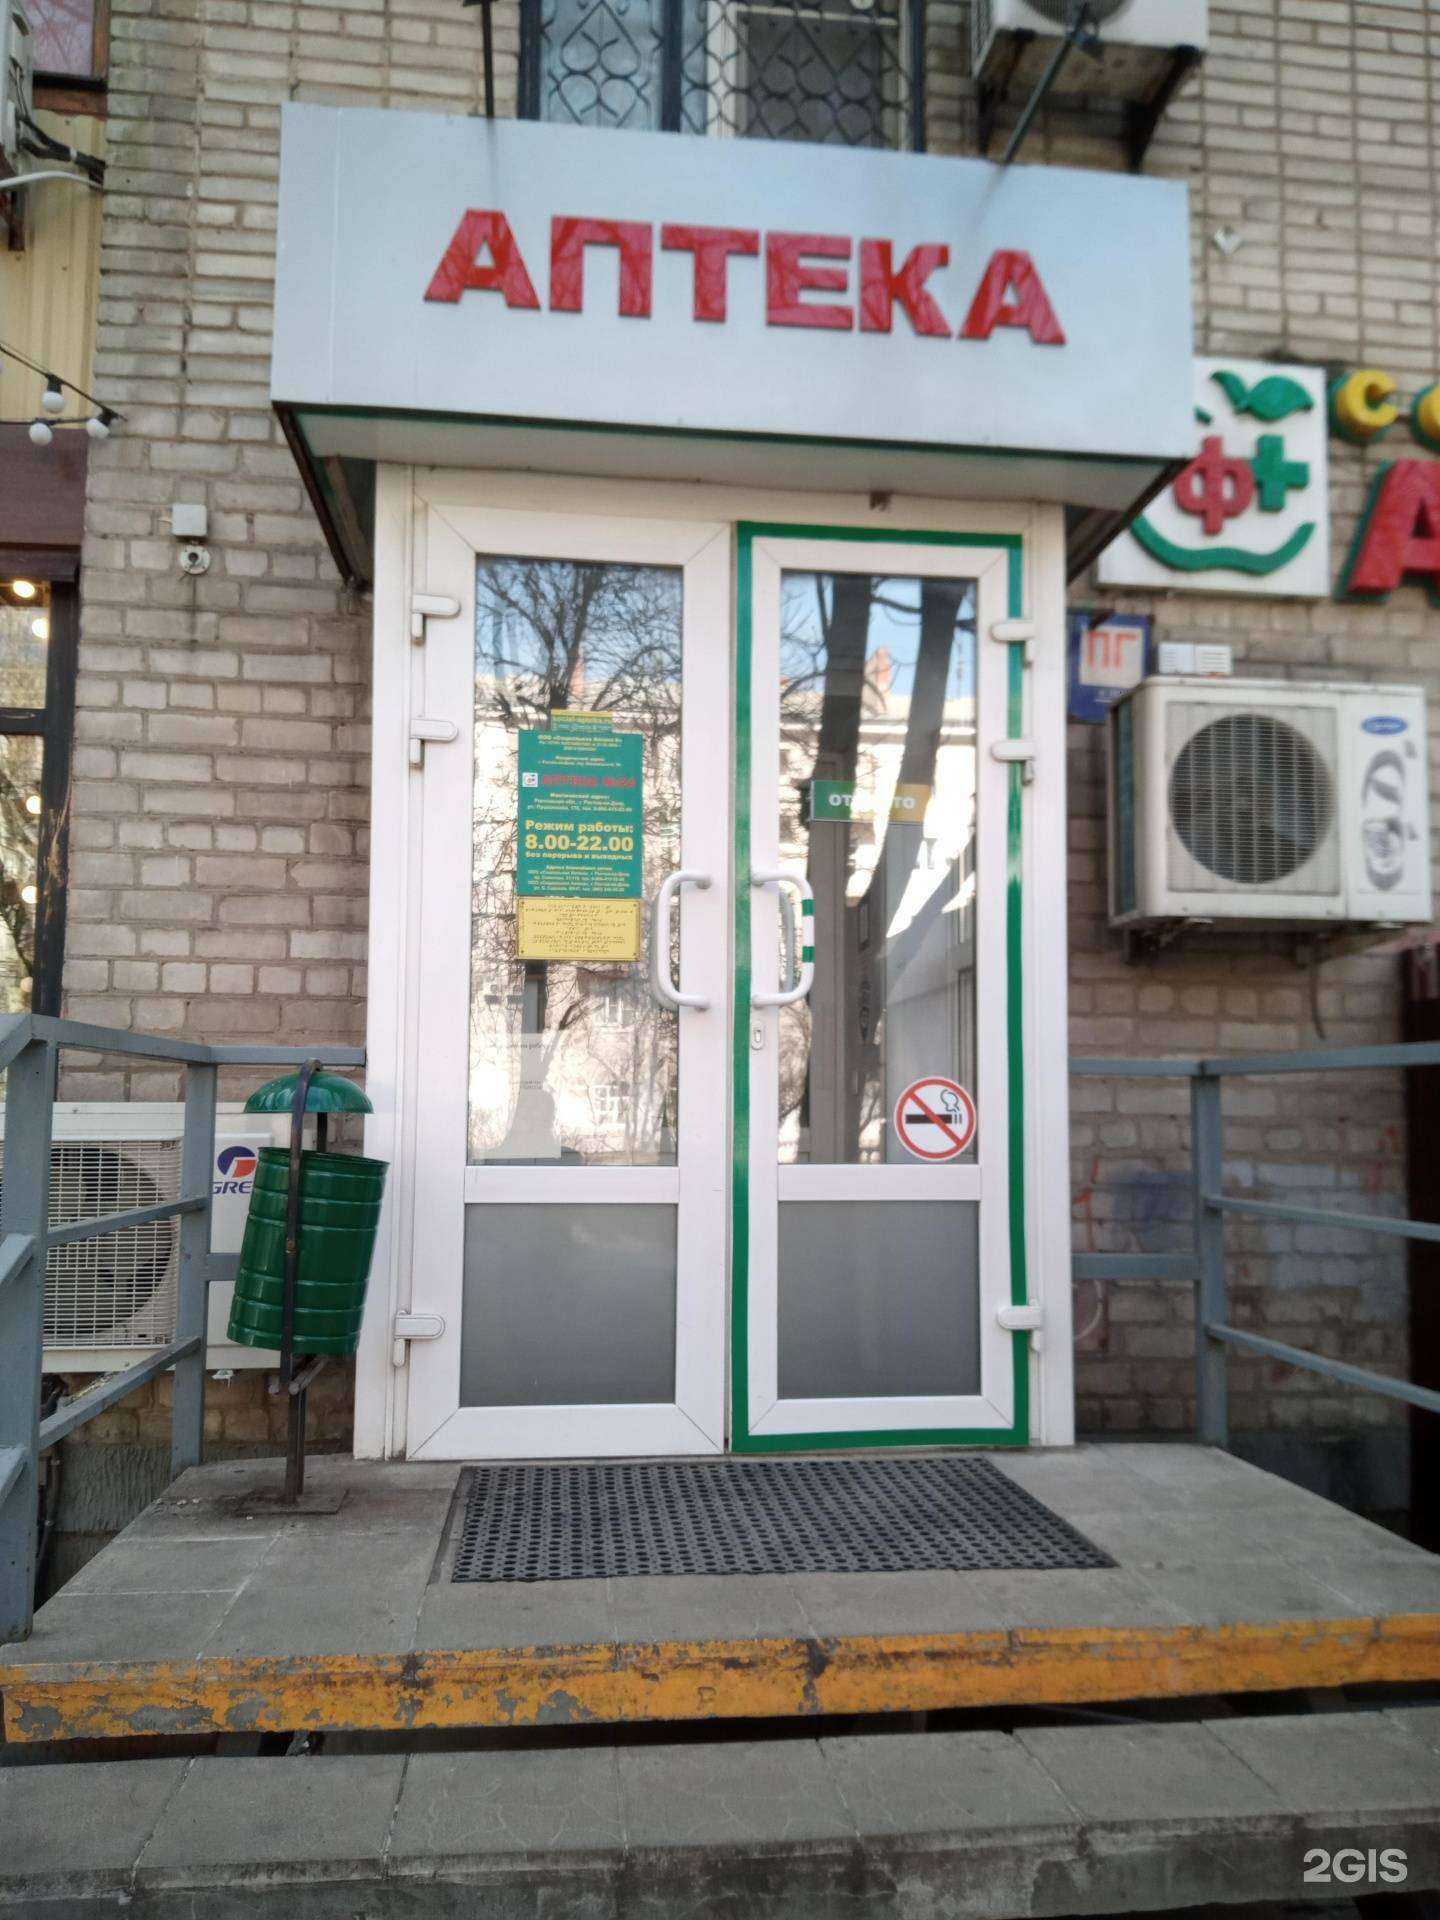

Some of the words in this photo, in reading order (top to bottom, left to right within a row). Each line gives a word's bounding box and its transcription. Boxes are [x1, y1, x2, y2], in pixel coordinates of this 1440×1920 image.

[424, 209, 1067, 346] АПТЕКА
[829, 793, 917, 810] ОТТО
[525, 819, 575, 832] Режим
[578, 821, 634, 834] работы:
[525, 833, 634, 852] 8.00-22.00
[211, 1181, 253, 1194] GRE
